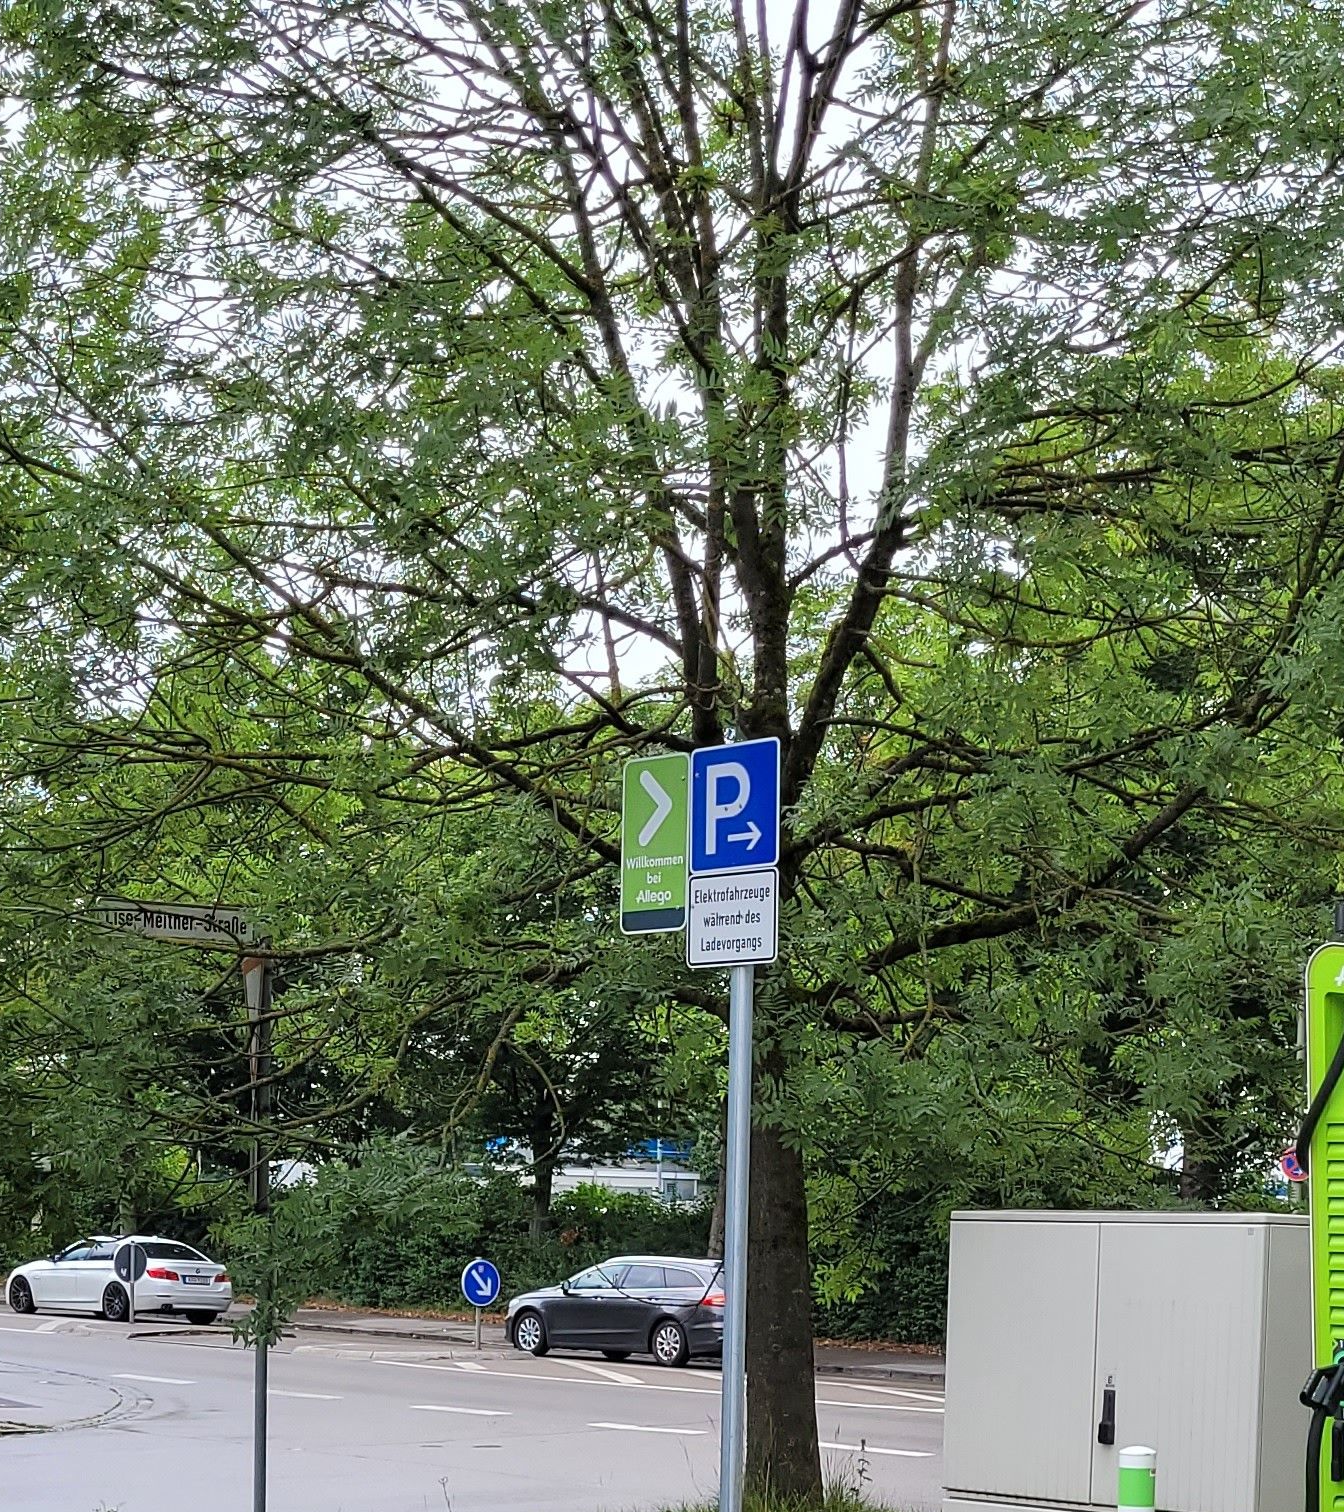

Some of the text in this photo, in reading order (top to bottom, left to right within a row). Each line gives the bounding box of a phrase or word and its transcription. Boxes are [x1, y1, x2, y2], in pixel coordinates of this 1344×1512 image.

[705, 761, 751, 856] P
[626, 856, 684, 869] Willkommen
[646, 872, 661, 884] bei
[636, 889, 672, 906] Allego
[694, 886, 771, 904] Elektrofahrzeuge
[703, 909, 761, 927] während des
[700, 936, 762, 953] Ladevorgangs
